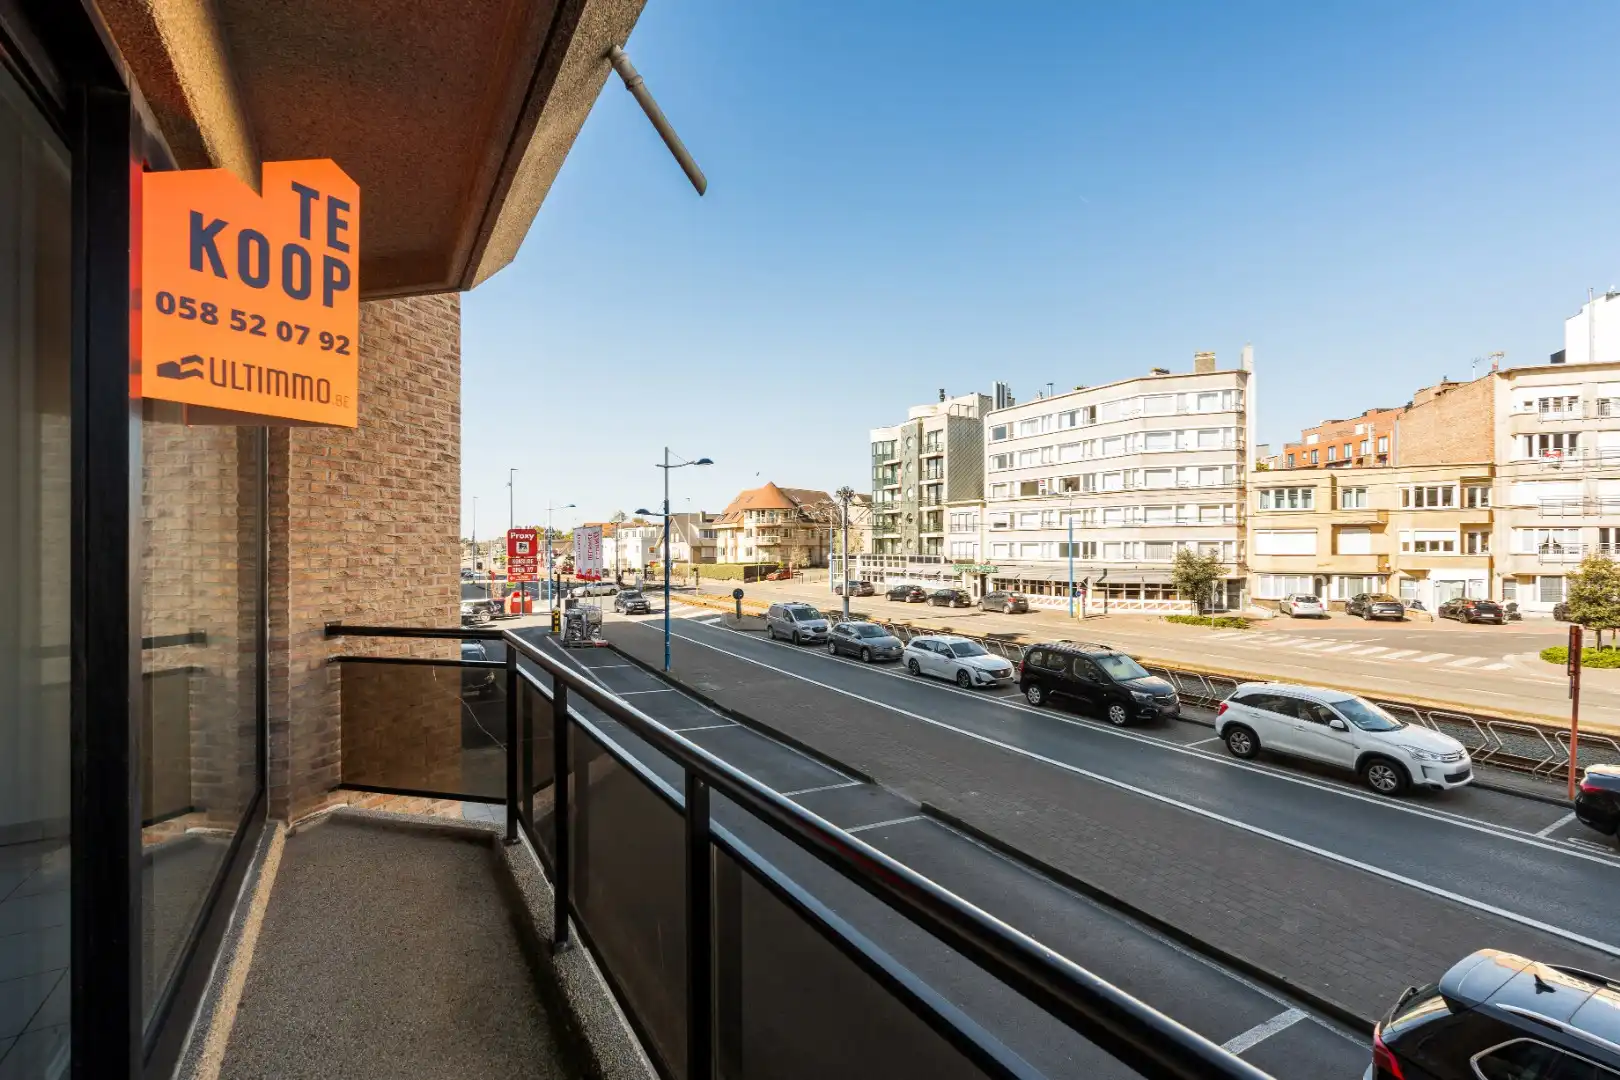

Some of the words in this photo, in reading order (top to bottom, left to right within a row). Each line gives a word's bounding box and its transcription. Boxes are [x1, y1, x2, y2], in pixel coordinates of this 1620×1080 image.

[291, 180, 350, 254] TE
[189, 209, 351, 308] KOOP
[155, 291, 219, 326] 058
[229, 308, 267, 338] 52
[276, 321, 311, 346] 07
[319, 331, 350, 356] 92
[510, 532, 535, 541] Proxy
